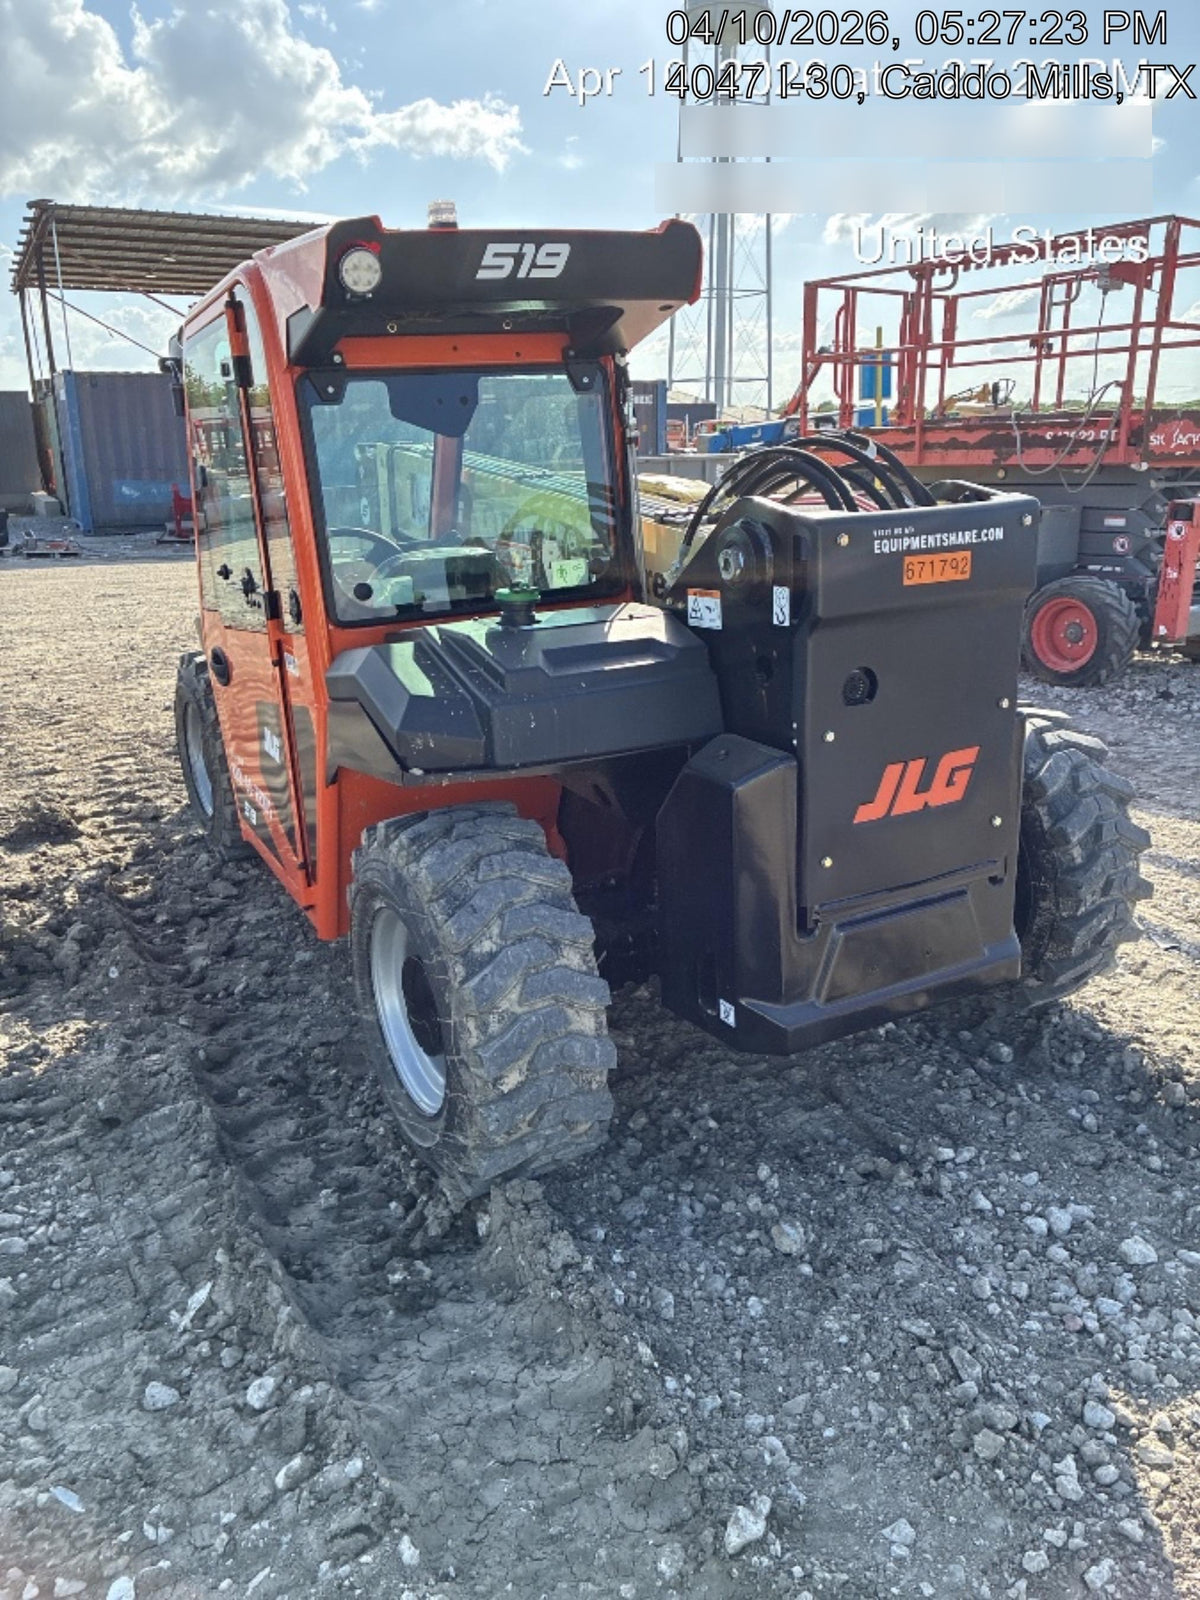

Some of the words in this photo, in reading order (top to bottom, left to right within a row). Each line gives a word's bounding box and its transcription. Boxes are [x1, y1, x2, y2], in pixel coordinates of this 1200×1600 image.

[475, 243, 571, 279] 519
[906, 556, 968, 580] 671792
[853, 746, 980, 824] JLG
